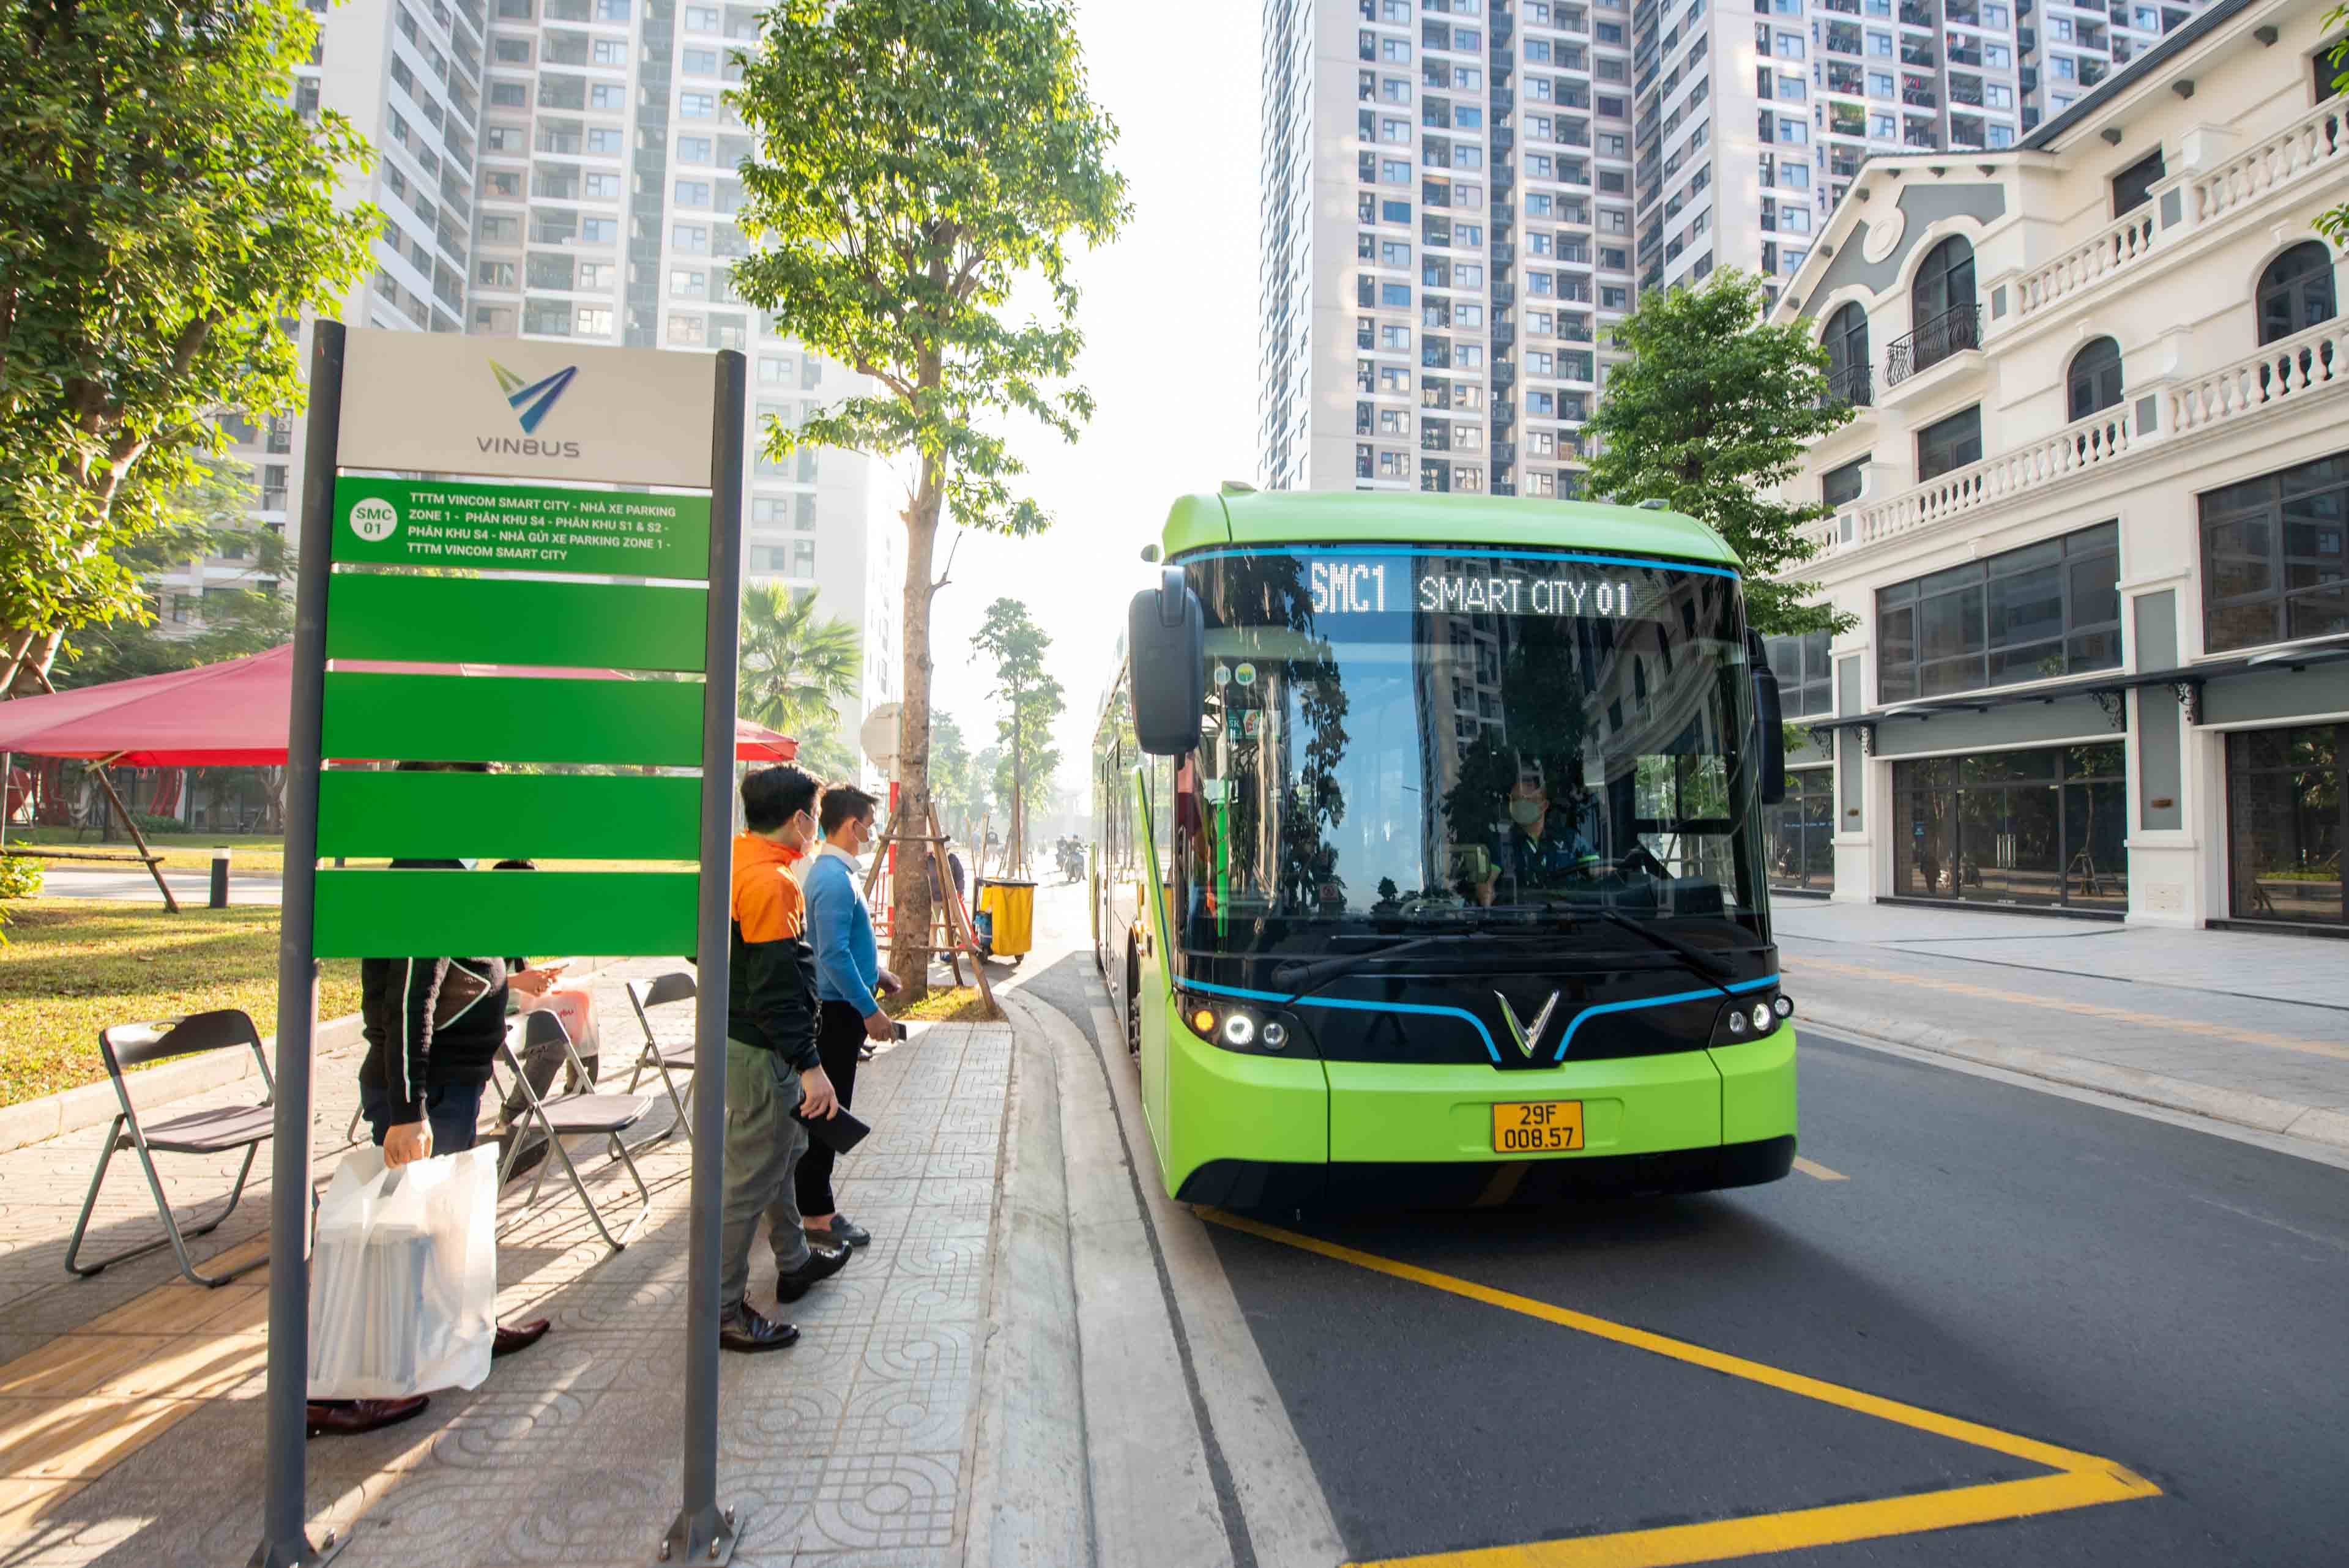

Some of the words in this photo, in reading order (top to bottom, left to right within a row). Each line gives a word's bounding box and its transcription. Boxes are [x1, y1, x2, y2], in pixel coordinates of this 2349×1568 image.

[477, 436, 580, 458] VINBUS
[356, 507, 392, 520] SMC
[409, 492, 444, 505] TTTM
[448, 494, 496, 507] VINCOM
[499, 497, 541, 509] SMART
[543, 499, 570, 511] CITY
[581, 500, 606, 513] NHÀ
[608, 503, 624, 515] XE
[627, 504, 676, 517] PARKING
[364, 522, 381, 534] 01
[409, 509, 441, 521] ZONE
[445, 511, 450, 521] 1
[466, 511, 499, 524] PHÂN
[502, 514, 527, 525] KHU
[530, 516, 545, 526] S4
[556, 516, 589, 529] PHÂN
[592, 519, 616, 530] KHU
[619, 521, 632, 531] S1
[636, 521, 644, 532] &
[647, 522, 661, 533] S2
[408, 524, 442, 538] PHÂN
[445, 527, 471, 538] KHU
[474, 529, 488, 540] S4
[499, 529, 525, 541] NHÀ
[551, 533, 567, 544] XE
[570, 534, 620, 548] PARKING
[623, 537, 653, 548] ZONE
[657, 539, 662, 549] 1
[407, 542, 442, 554] TTTM
[445, 544, 493, 557] VINCOM
[496, 546, 538, 559] SMART
[540, 549, 567, 560] CITY
[1311, 562, 1385, 613] SMC1
[1419, 576, 1522, 612] SMART
[1532, 579, 1587, 614] CITY
[1596, 582, 1627, 616] 01
[1520, 1105, 1557, 1124] 29F
[1505, 1127, 1574, 1148] 008.57
